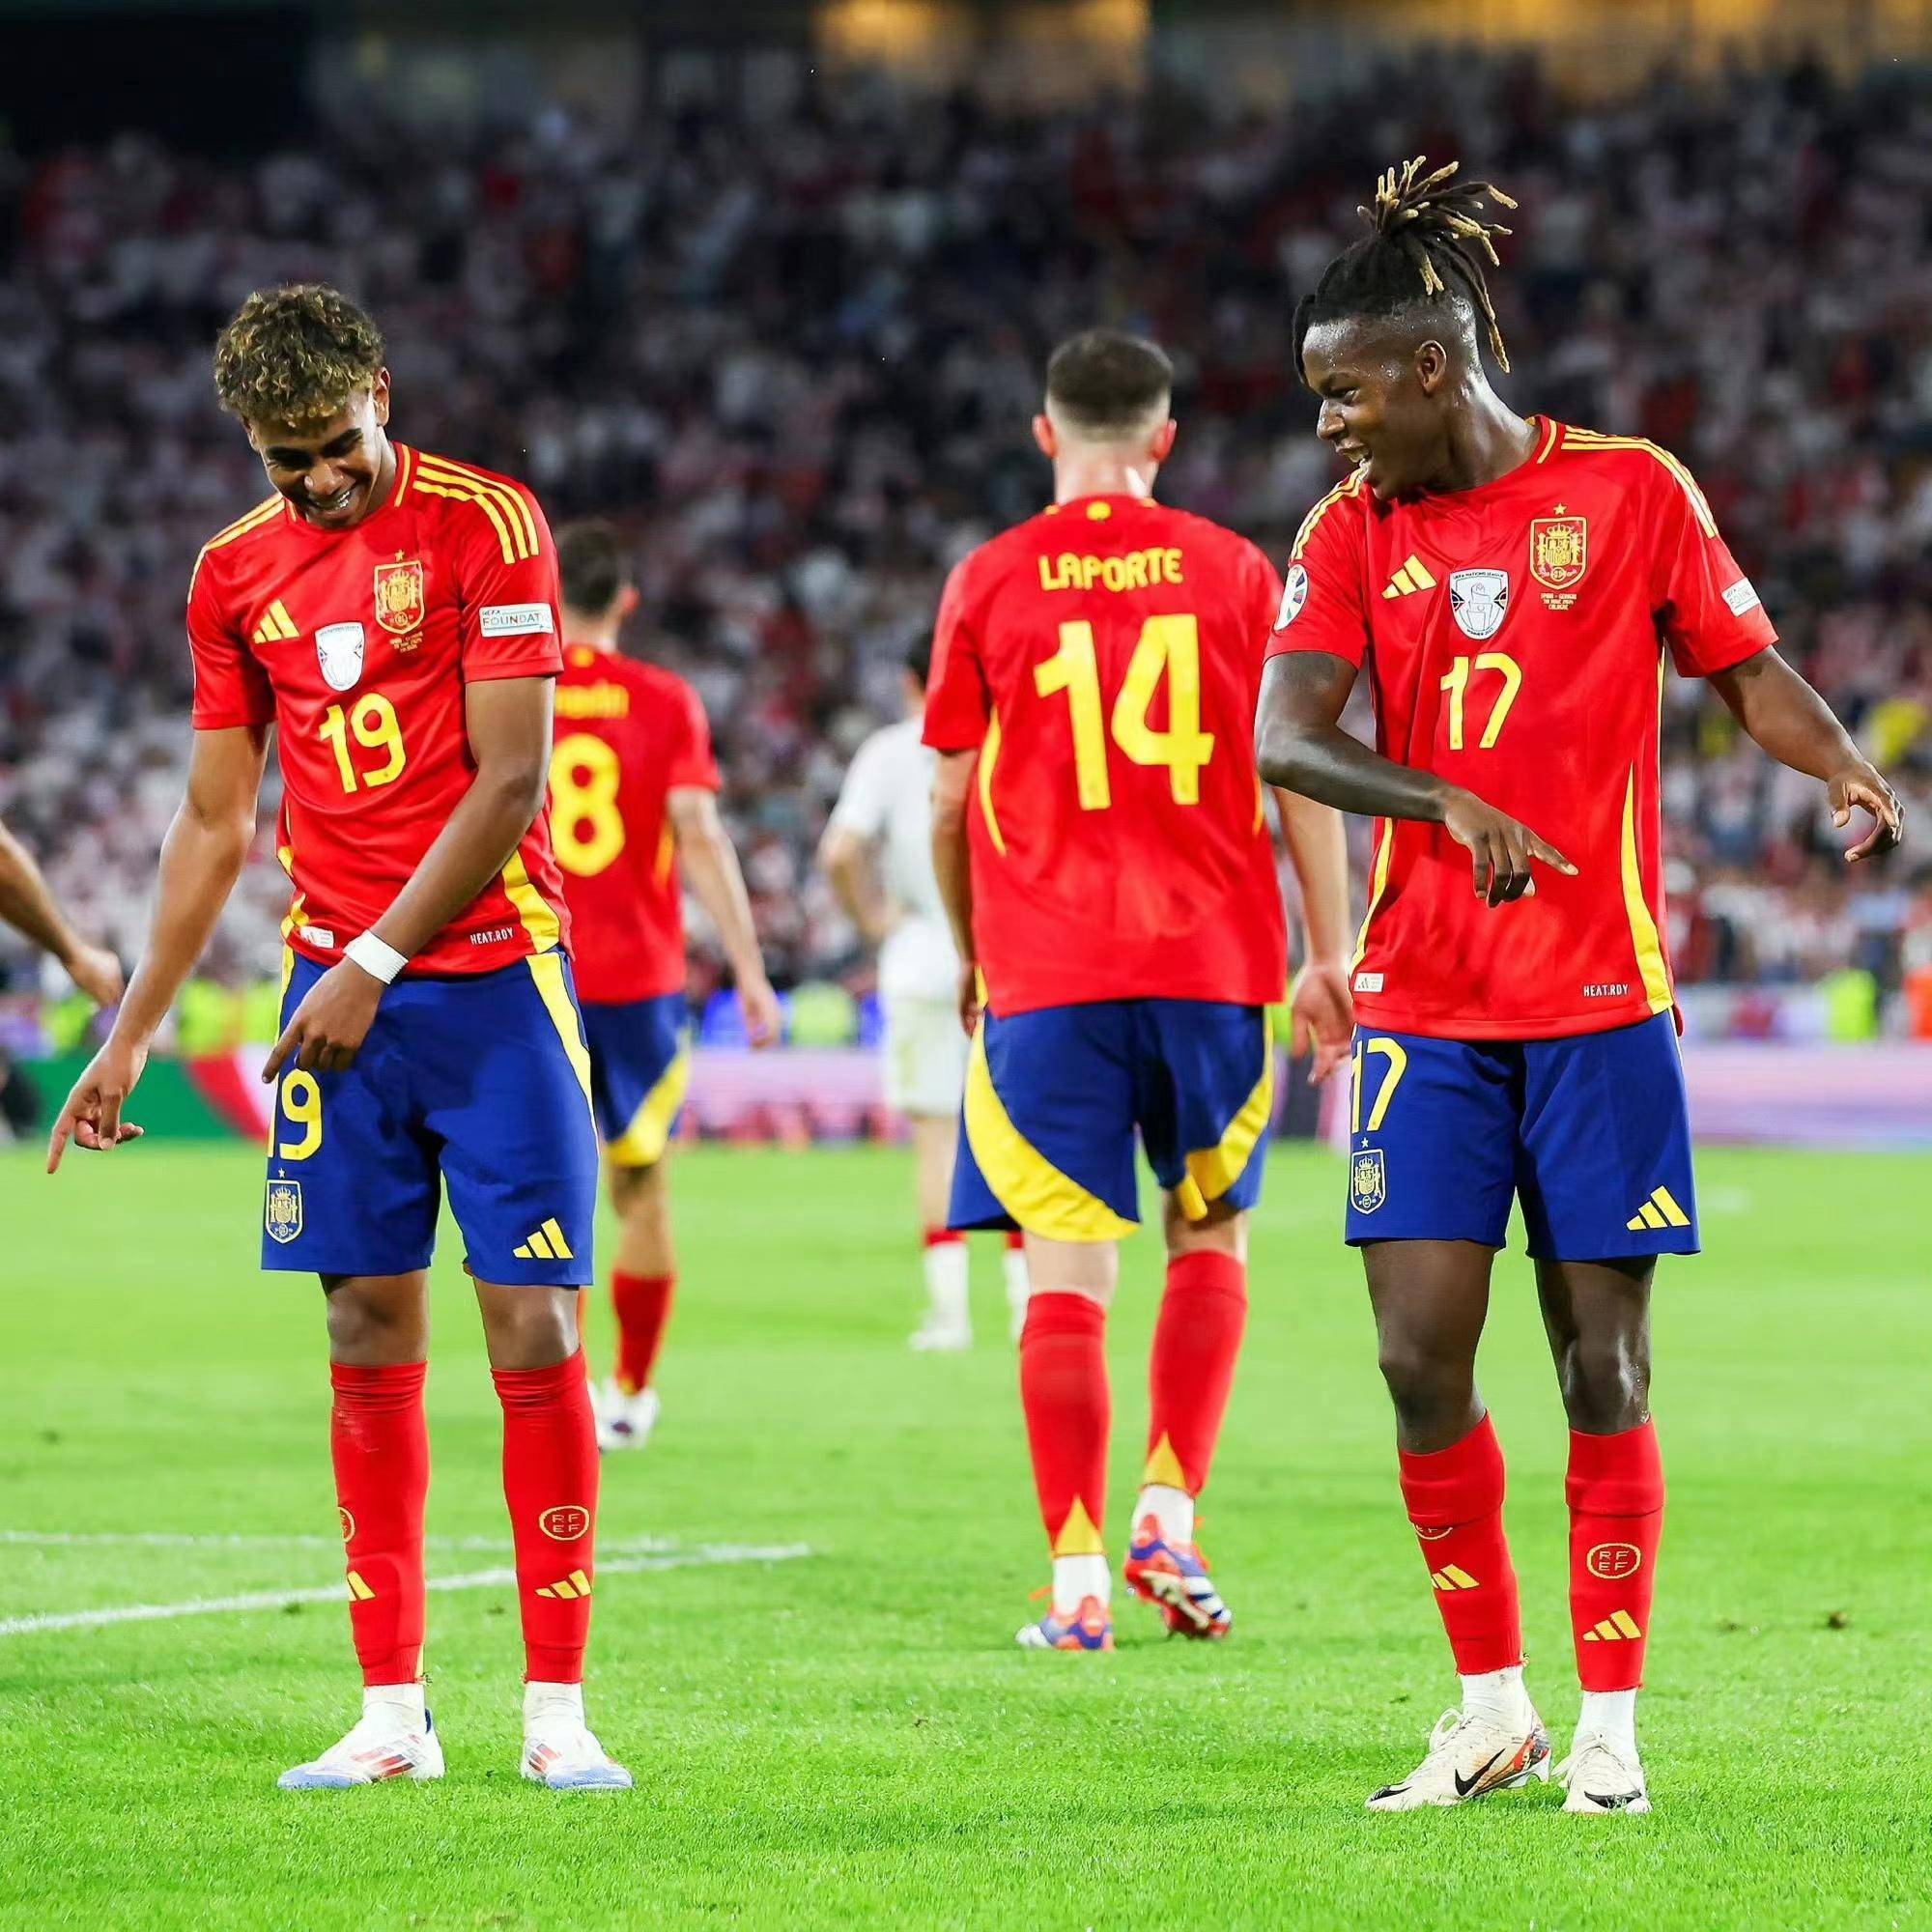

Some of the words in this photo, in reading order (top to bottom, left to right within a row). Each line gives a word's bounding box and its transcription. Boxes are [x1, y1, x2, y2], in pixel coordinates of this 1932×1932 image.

[1038, 547, 1184, 592] LAPORTE
[319, 693, 407, 794] 19
[1034, 613, 1214, 810] 14
[1440, 652, 1522, 751] 17
[549, 732, 626, 877] 8
[1351, 1037, 1407, 1134] 17
